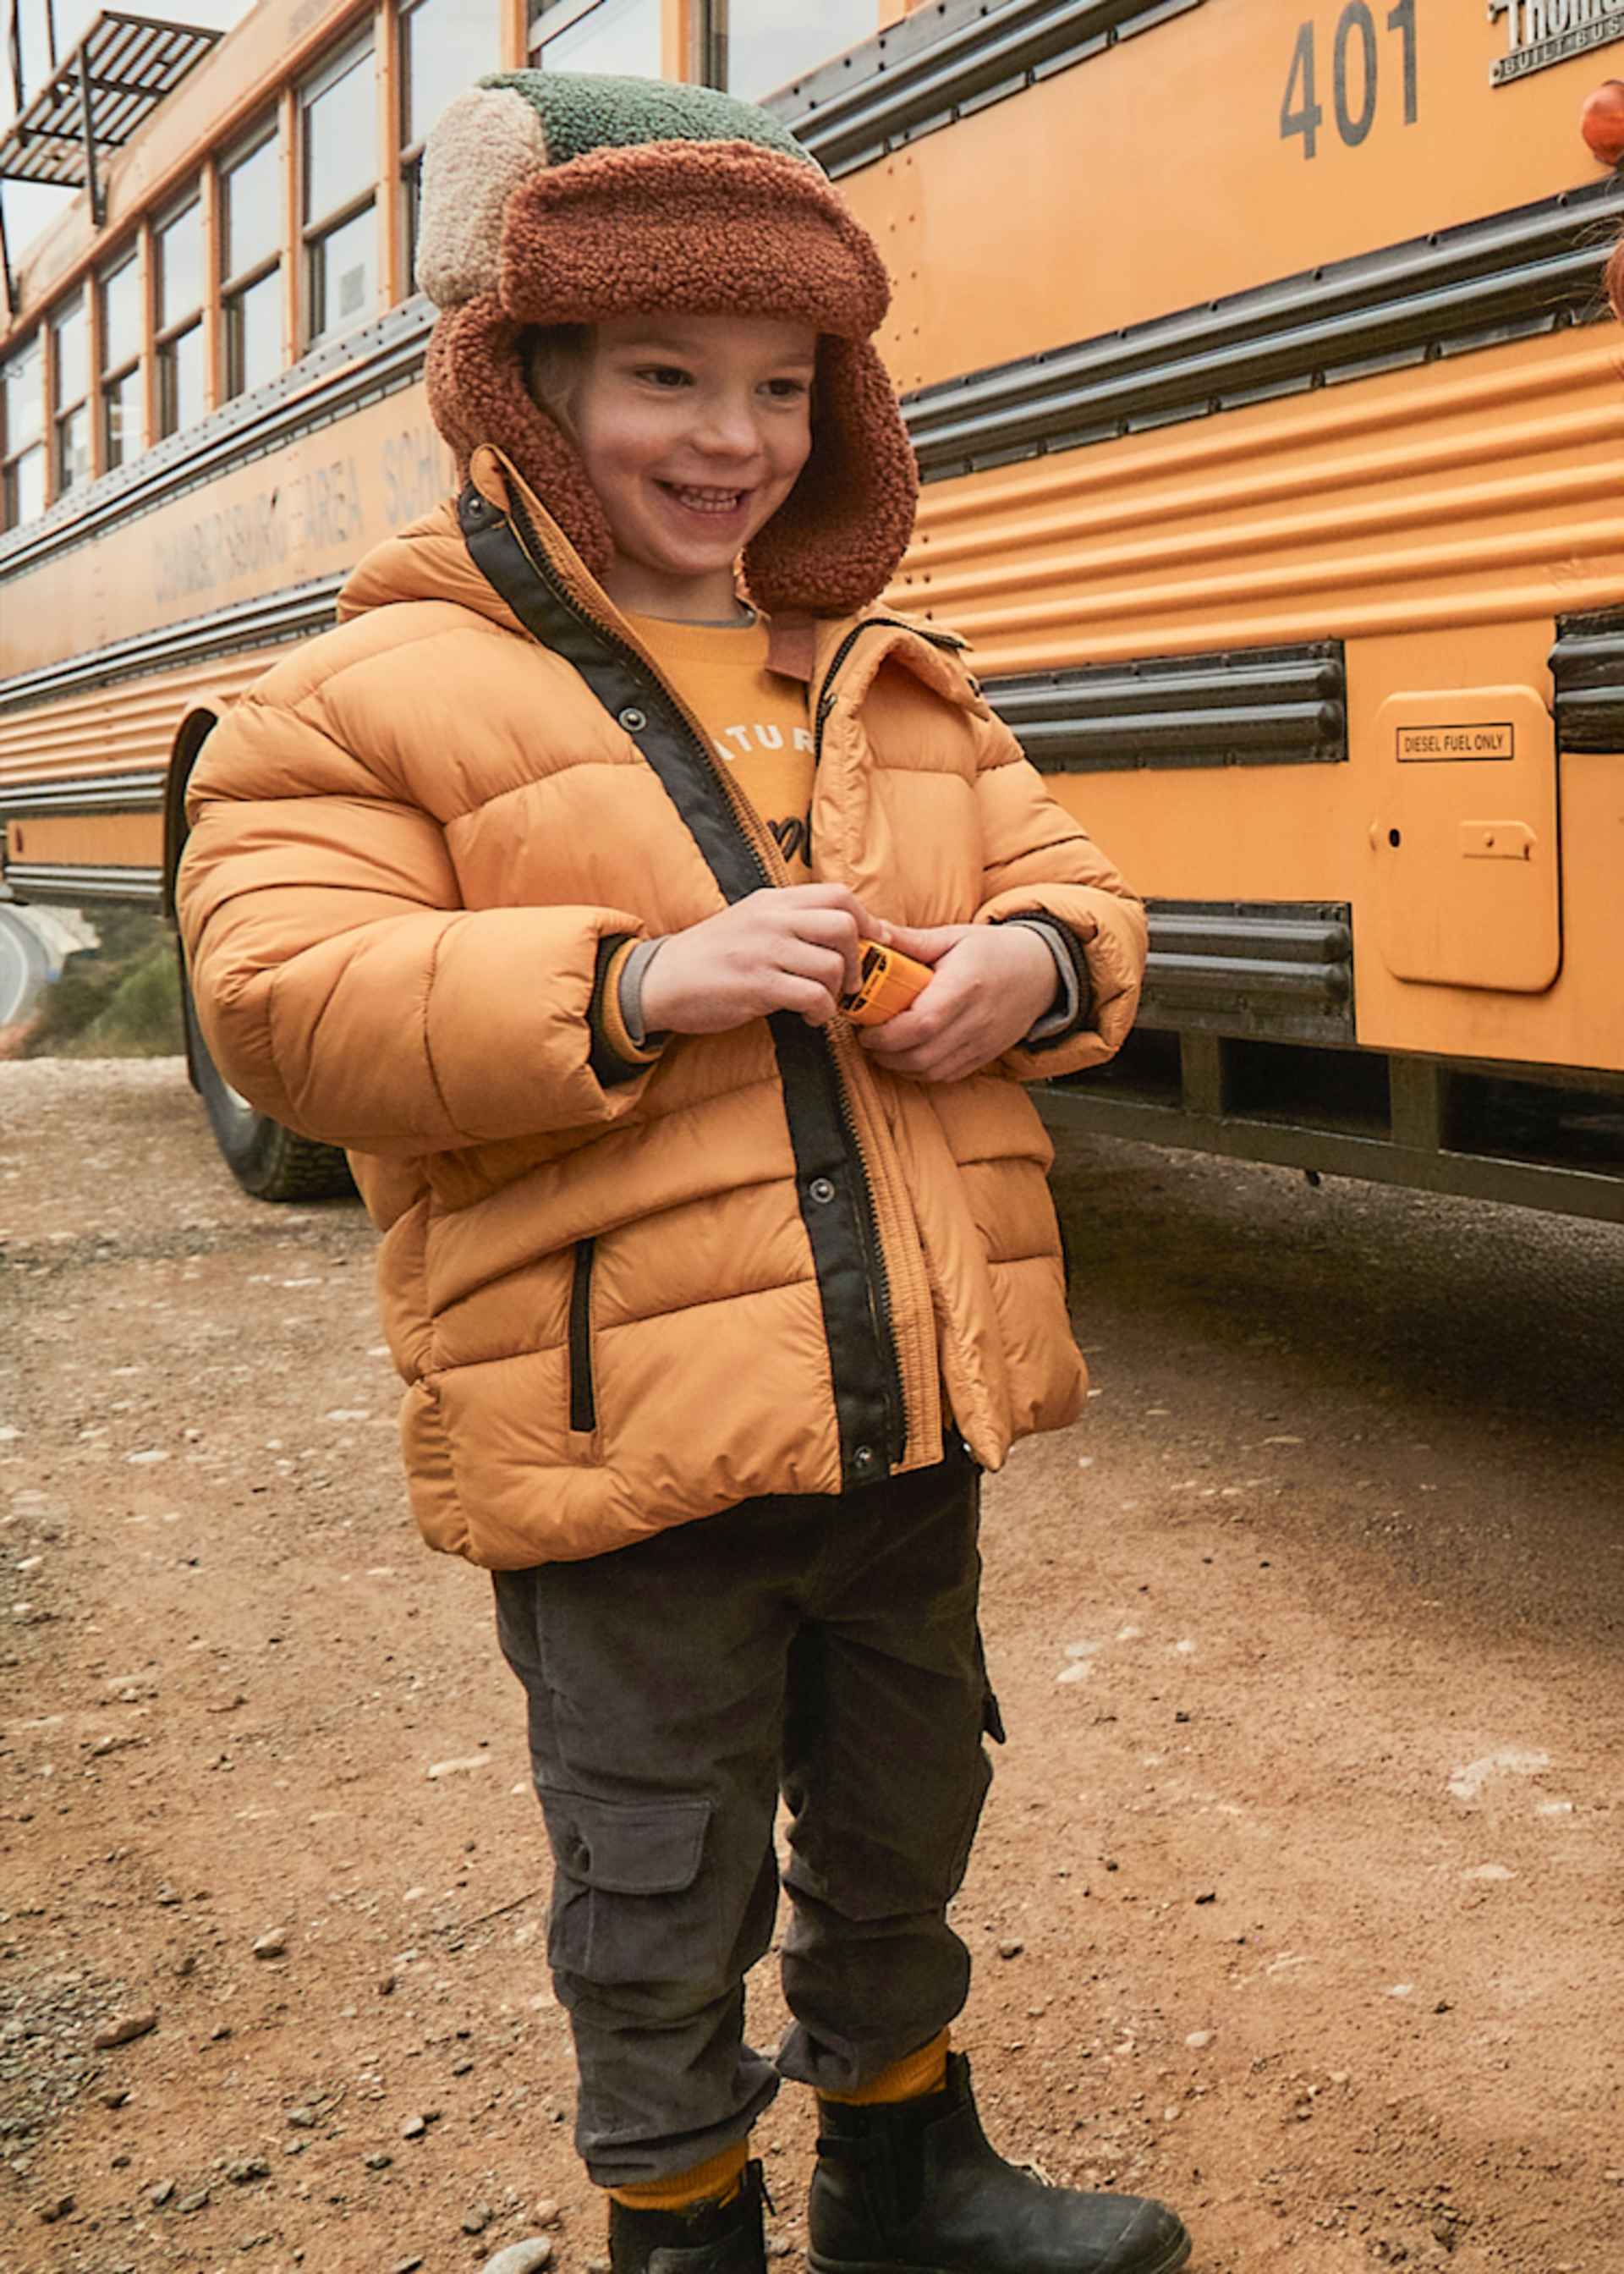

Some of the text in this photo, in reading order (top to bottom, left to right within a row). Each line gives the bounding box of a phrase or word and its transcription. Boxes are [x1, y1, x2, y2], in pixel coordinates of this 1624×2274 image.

[1504, 38, 1564, 74] BUILT
[1280, 0, 1418, 161] 401
[1404, 733, 1504, 753] DIESEL FUEL ONLY
